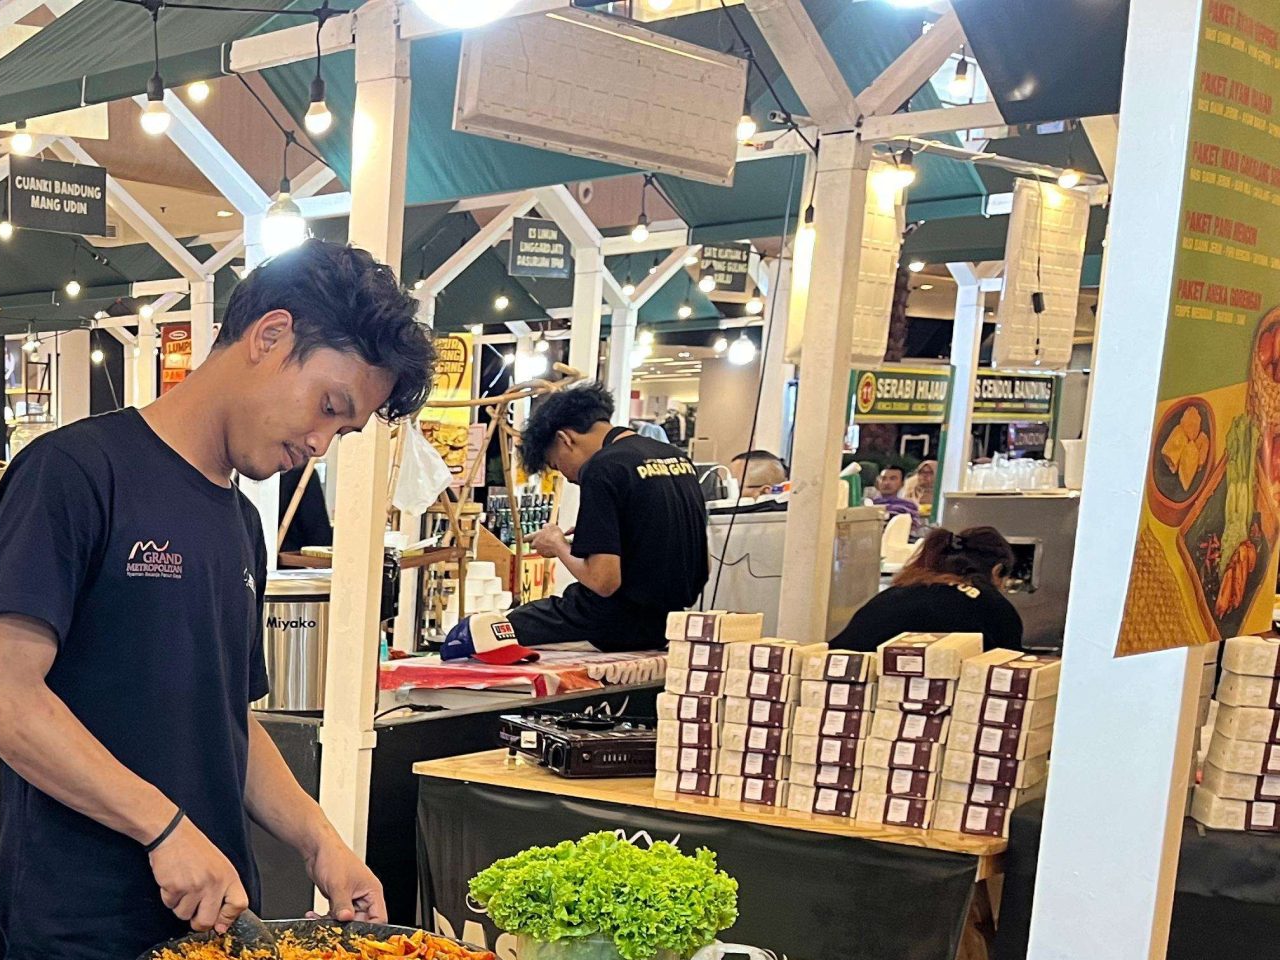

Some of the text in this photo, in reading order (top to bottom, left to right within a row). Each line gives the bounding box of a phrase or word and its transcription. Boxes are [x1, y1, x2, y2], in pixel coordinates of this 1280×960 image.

[15, 176, 102, 199] CUANKI BANDUNG
[30, 195, 88, 214] MANG UDIN
[1178, 279, 1205, 302] PAKET
[876, 377, 915, 399] SERABI
[916, 380, 949, 400] HIJAU
[982, 379, 1014, 399] CENDOL
[143, 551, 183, 565] GRAND
[126, 562, 183, 574] METROPOLITAN
[266, 616, 317, 631] Miyako
